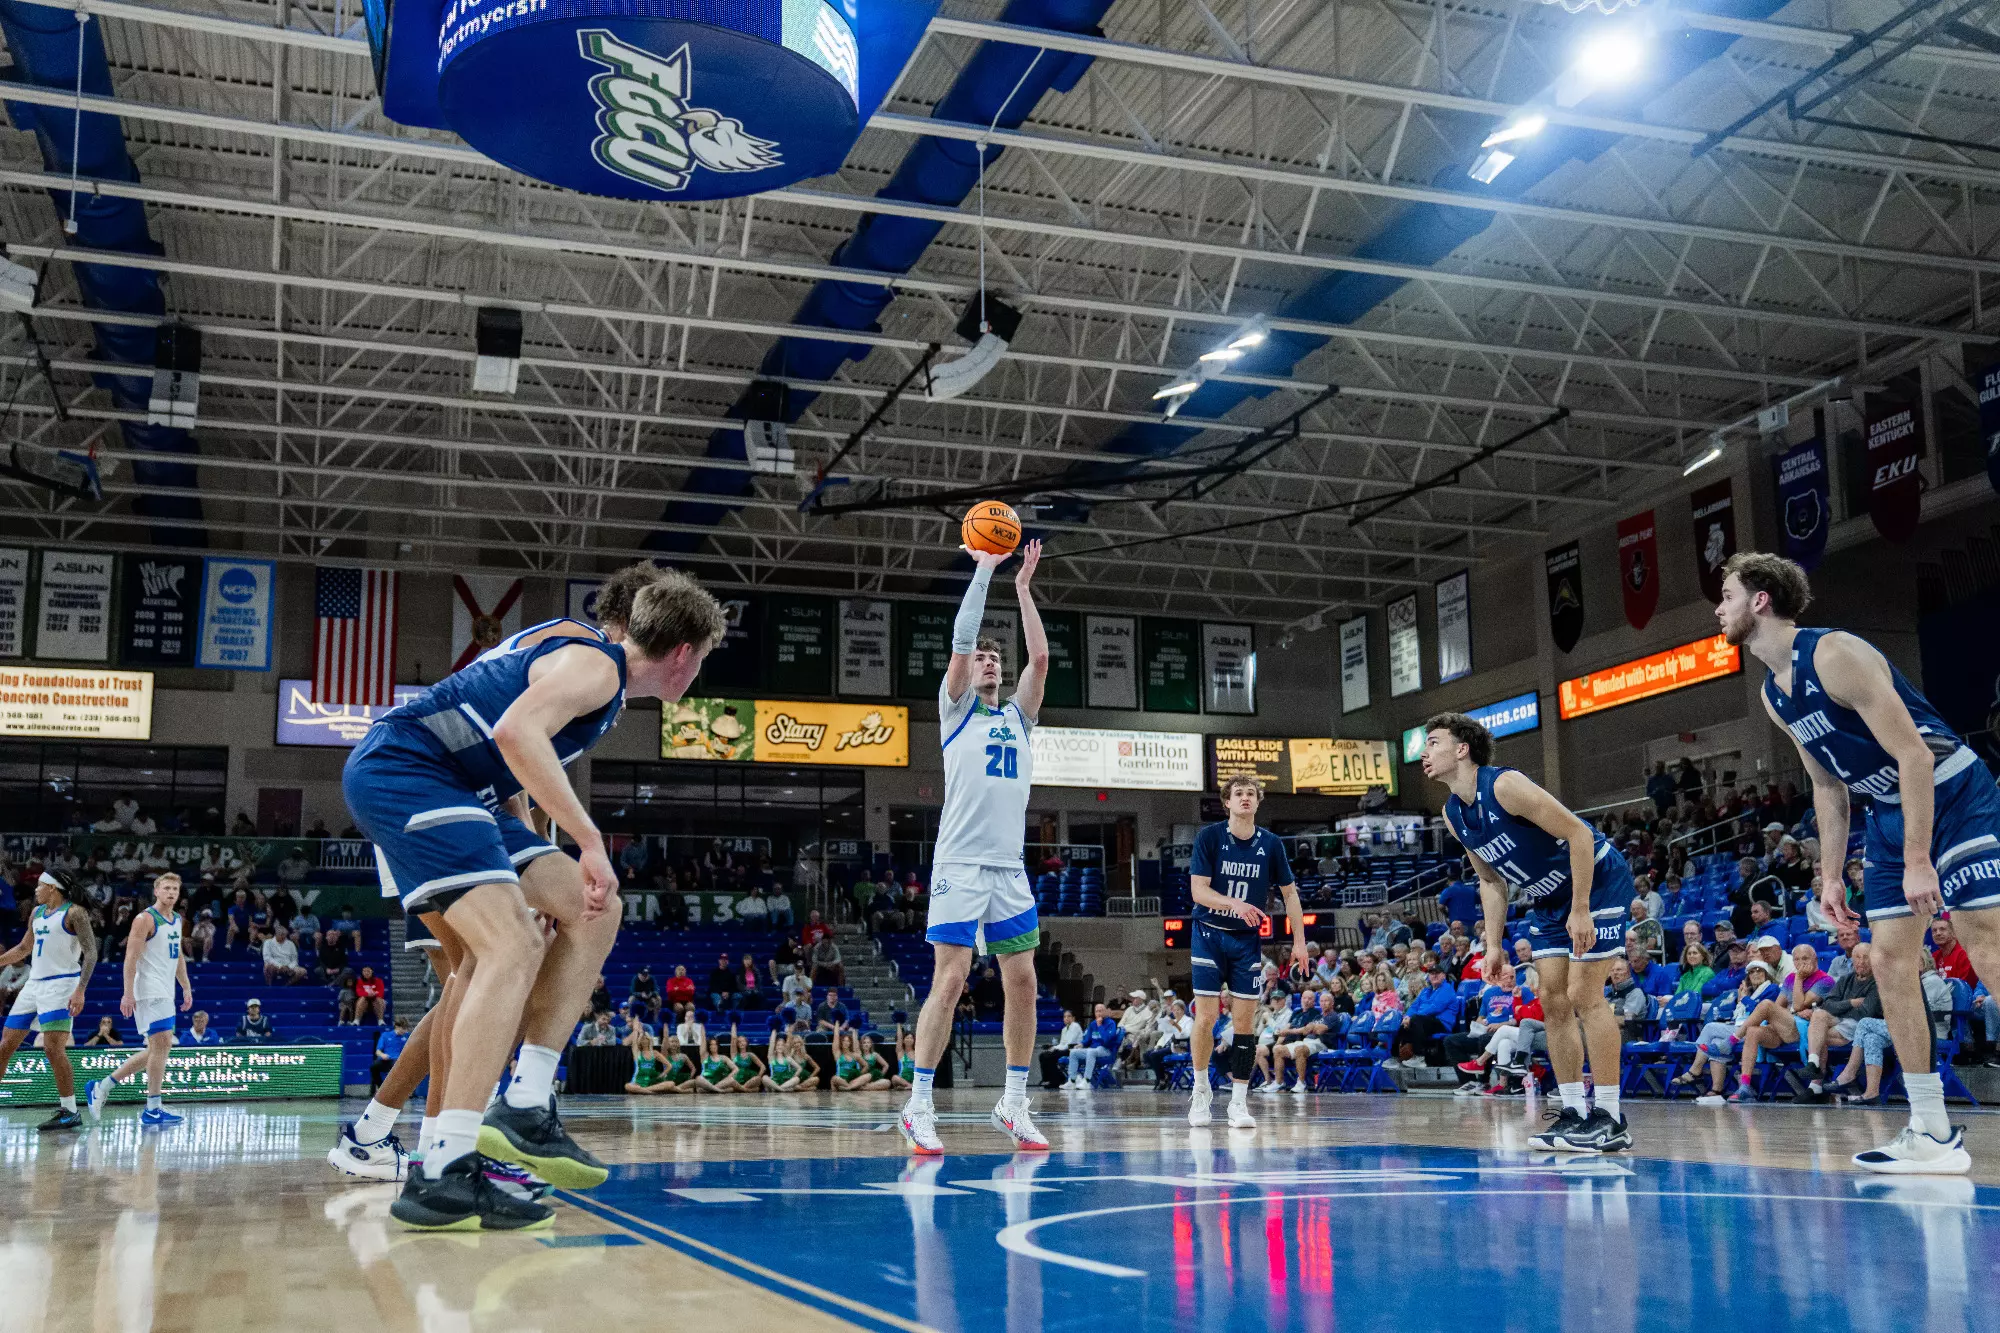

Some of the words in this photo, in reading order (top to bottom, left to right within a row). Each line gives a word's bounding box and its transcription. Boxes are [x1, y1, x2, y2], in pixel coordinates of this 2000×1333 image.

[580, 30, 691, 190] FGCU
[1870, 409, 1911, 436] EASTERN
[1868, 421, 1915, 450] KENTUCKY
[1780, 449, 1817, 471] CENTRAL
[1779, 460, 1821, 486] ARKANSAS
[1874, 453, 1918, 486] EKU
[53, 561, 104, 574] ASUN
[1093, 626, 1130, 638] ASUN
[1211, 636, 1247, 647] ASUN
[219, 649, 248, 661] 2007
[22, 674, 95, 691] Foundations
[98, 678, 110, 691] of
[113, 679, 143, 692] Trust
[1593, 673, 1626, 697] Blended
[1626, 666, 1645, 688] with
[1646, 660, 1666, 683] Care
[1679, 653, 1696, 671] You
[52, 692, 129, 708] Construction
[766, 713, 828, 751] Starry
[834, 725, 895, 752] FGCU
[1134, 742, 1189, 759] Hilton
[1215, 738, 1256, 752] EAGLES
[1258, 740, 1284, 753] RIDE
[1321, 741, 1359, 751] FLORIDA
[986, 744, 1018, 780] 20
[1118, 757, 1165, 769] Garden
[1167, 759, 1189, 771] Inn
[1216, 750, 1247, 762] WITH
[1248, 751, 1280, 764] PRIDE
[1330, 753, 1384, 782] EAGLE
[1220, 861, 1261, 879] NORTH
[1227, 879, 1249, 903] 10
[37, 939, 45, 956] 7
[168, 943, 180, 959] 15
[248, 1053, 306, 1070] Partner
